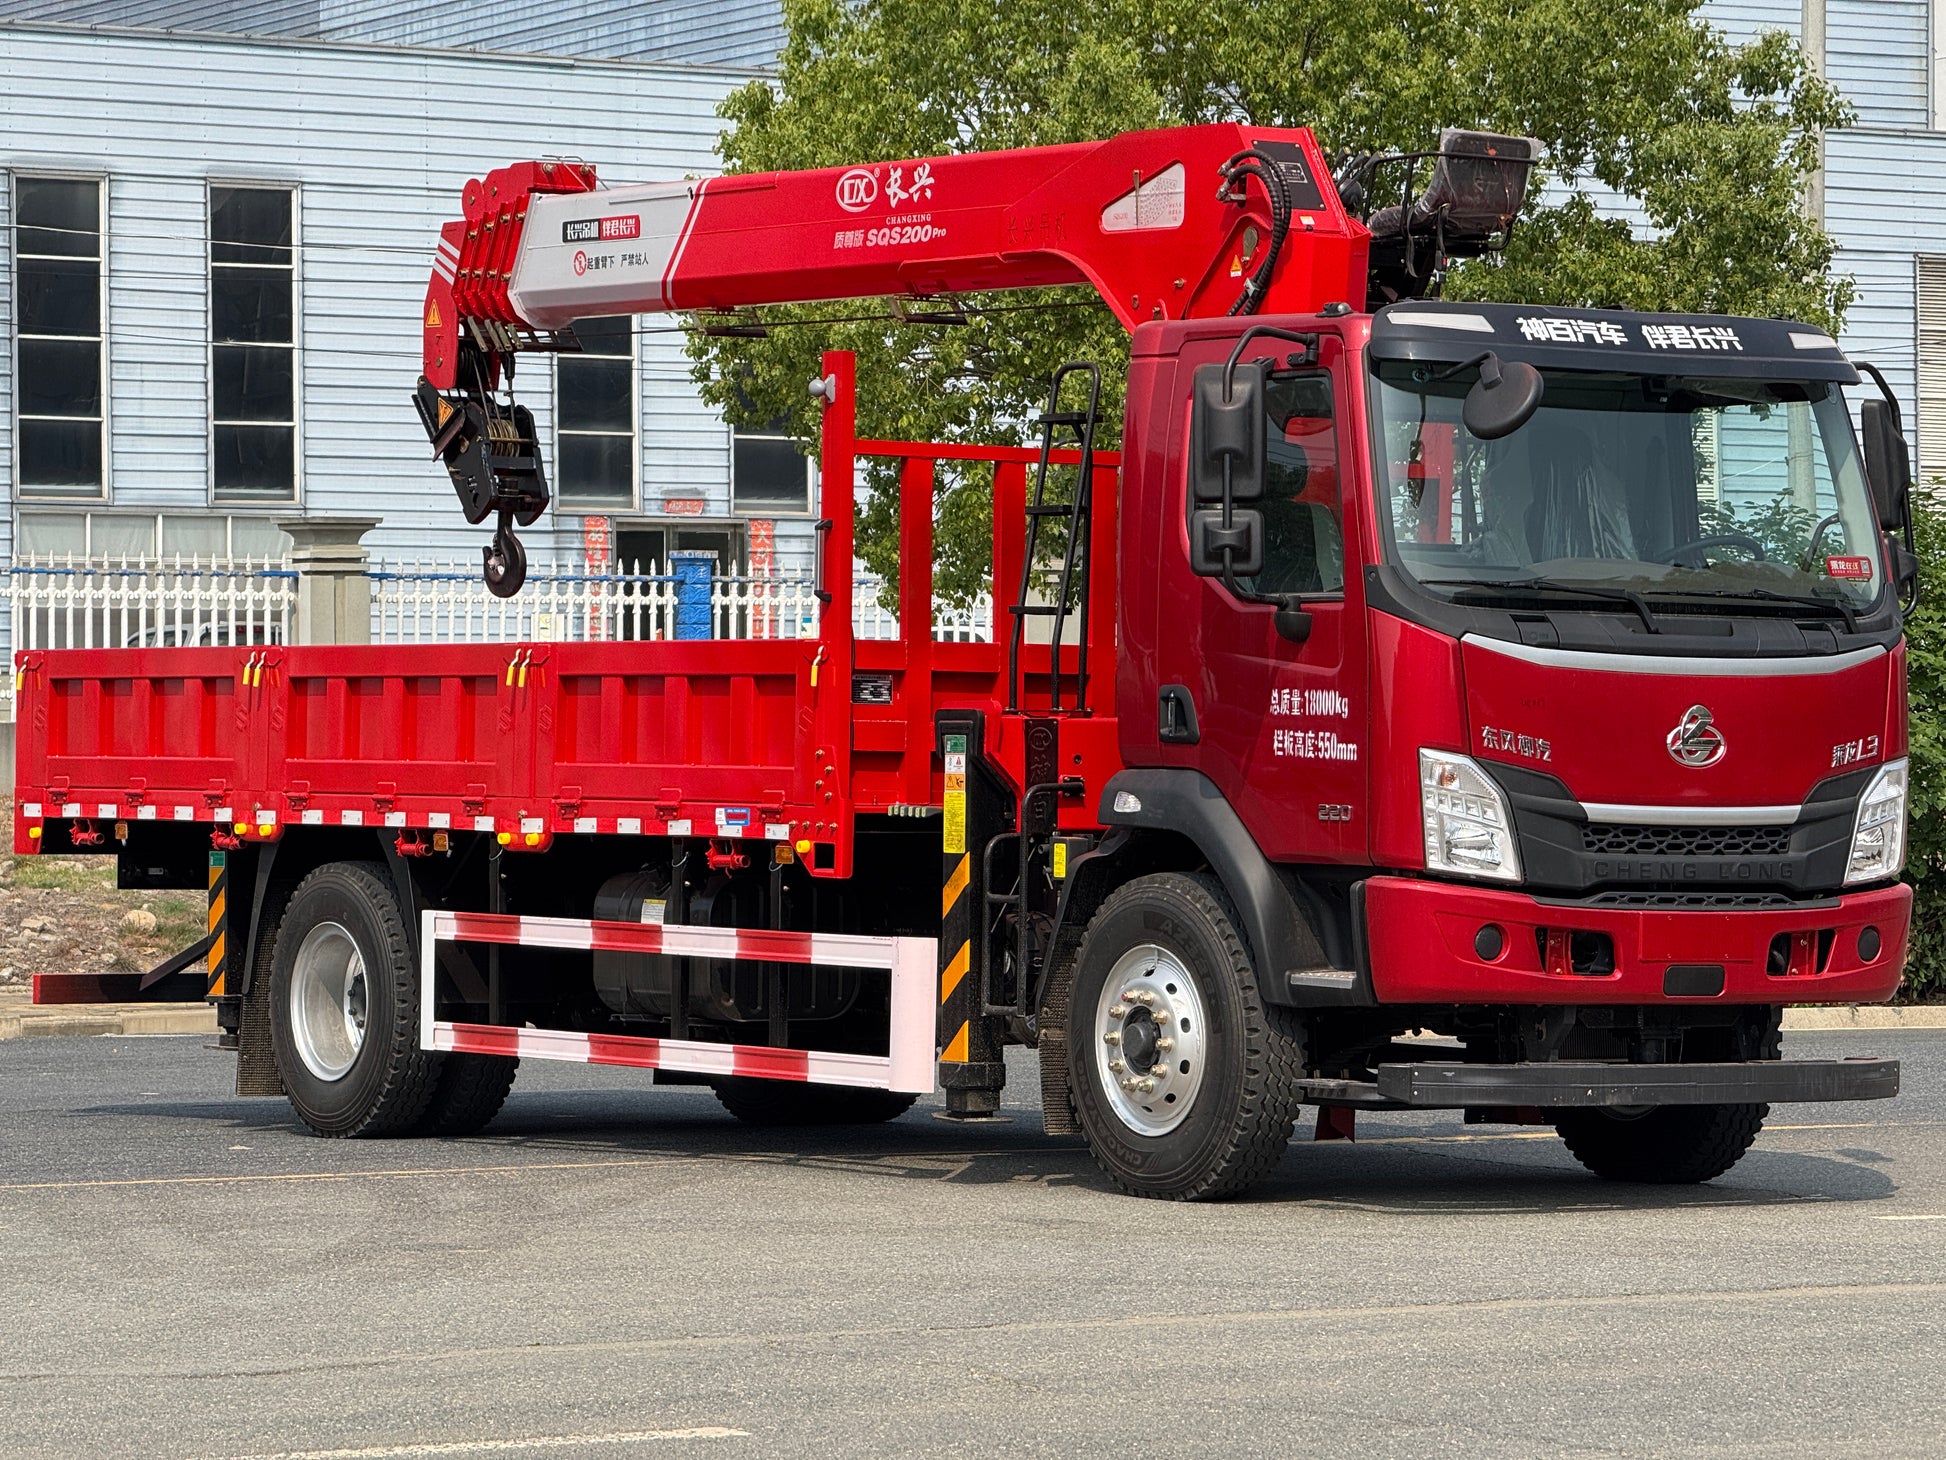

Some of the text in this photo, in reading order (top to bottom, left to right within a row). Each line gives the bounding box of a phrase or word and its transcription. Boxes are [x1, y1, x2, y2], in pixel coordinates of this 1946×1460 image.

[885, 162, 935, 208] 长兴
[886, 214, 931, 225] CHANGXING
[866, 225, 932, 247] SQS200
[932, 227, 947, 239] Pro
[587, 252, 649, 270] 起重臂下 严禁站人
[1516, 317, 1744, 350] 神百汽车 伴君长兴
[1270, 688, 1349, 718] 总质量:18000kg
[1273, 729, 1358, 760] 栏板高度:550mm
[1481, 725, 1552, 762] 东风柳汽
[1318, 804, 1352, 821] 220
[1594, 861, 1793, 880] CHENG LONG
